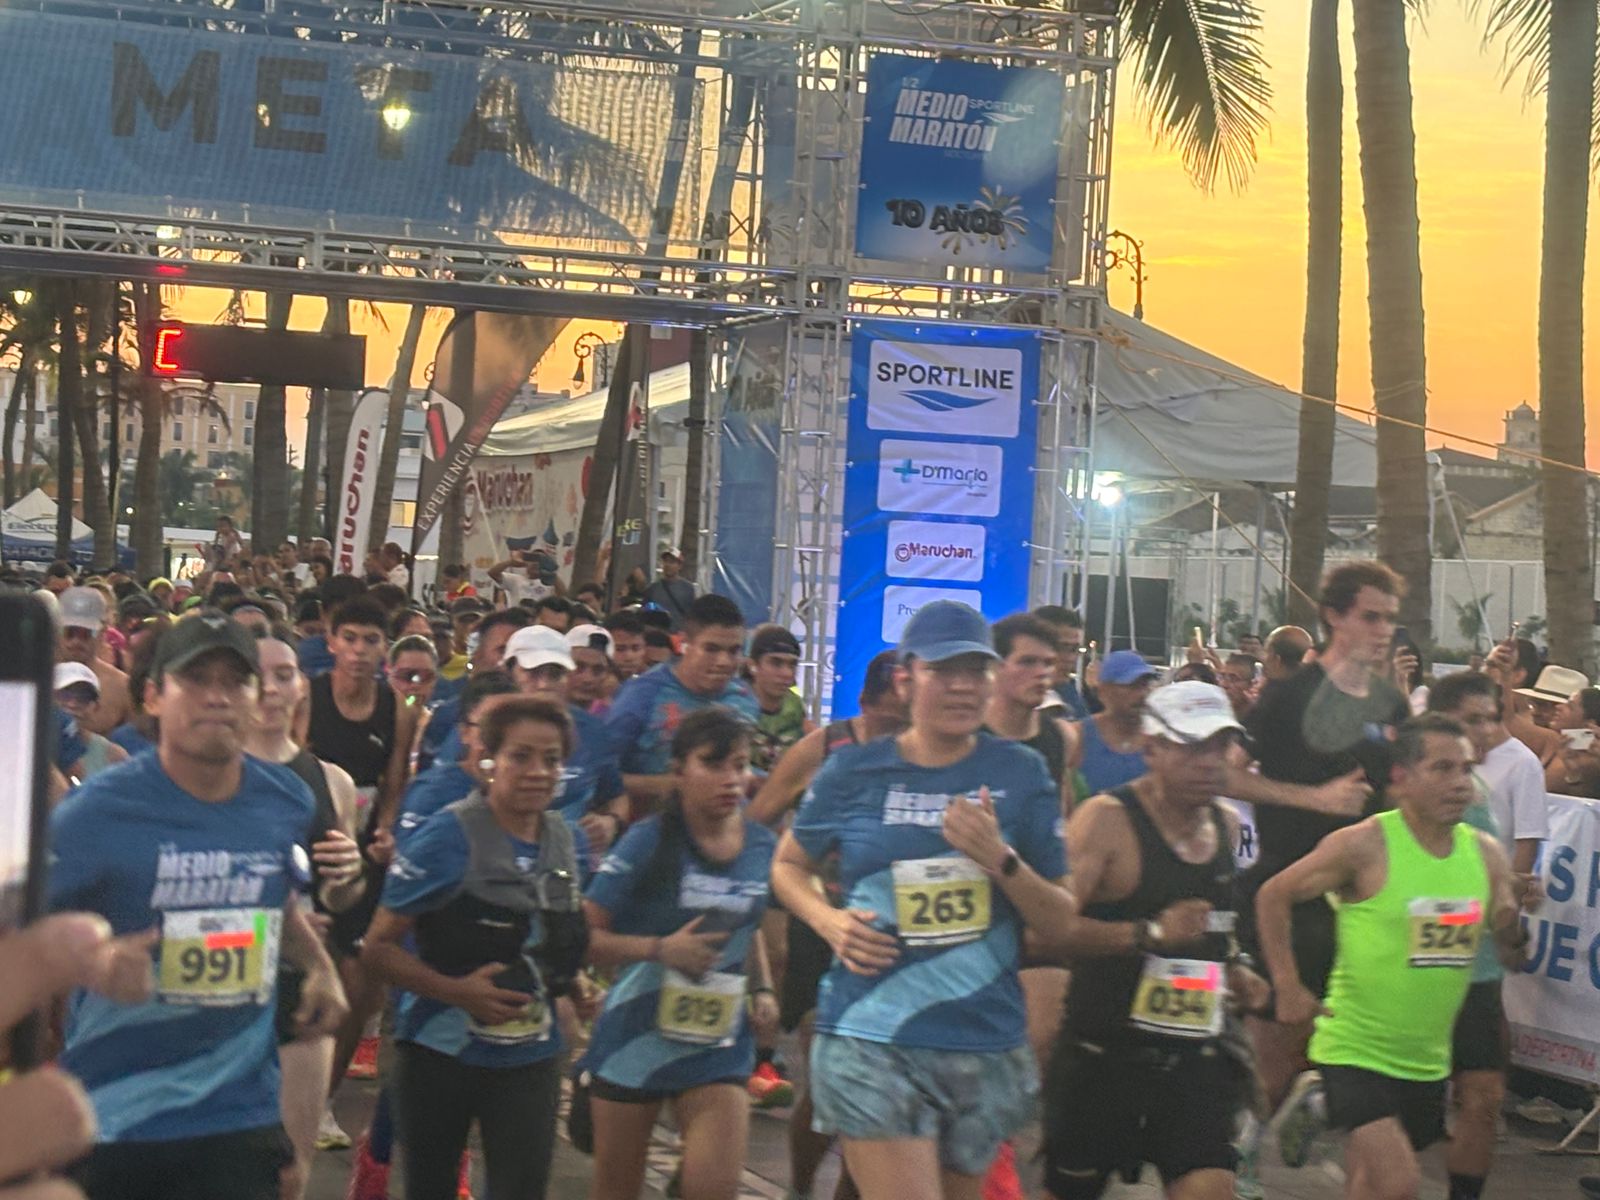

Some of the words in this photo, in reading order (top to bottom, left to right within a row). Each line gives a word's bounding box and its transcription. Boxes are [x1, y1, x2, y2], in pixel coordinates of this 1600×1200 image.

[111, 41, 537, 167] META
[895, 89, 969, 121] MEDIO
[969, 99, 1036, 115] SPORTLINE
[889, 116, 998, 151] MARATÓN
[886, 199, 925, 229] 10
[929, 202, 1006, 236] AÑOS
[877, 361, 1014, 390] SPORTLINE
[340, 429, 370, 576] aruchan
[416, 441, 478, 532] EXPERIENCIA
[909, 542, 974, 560] Maruchan
[909, 887, 976, 926] 263
[180, 945, 247, 985] 991
